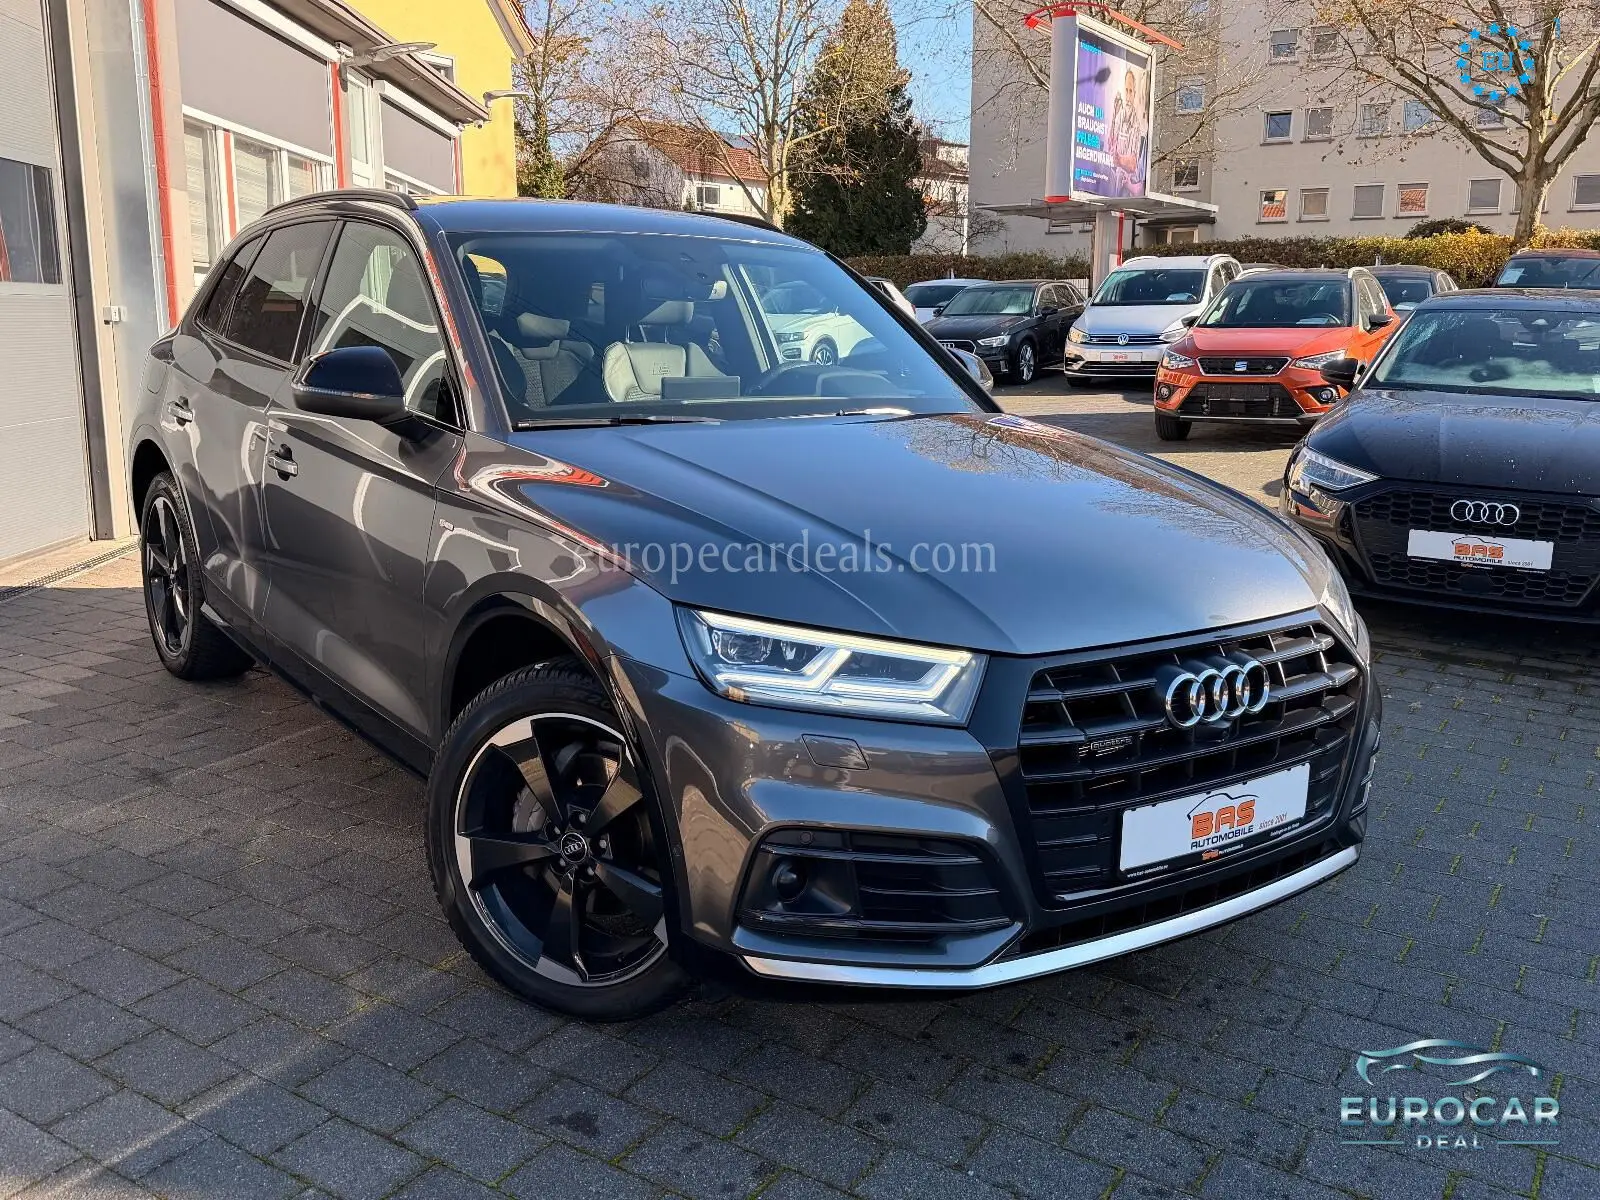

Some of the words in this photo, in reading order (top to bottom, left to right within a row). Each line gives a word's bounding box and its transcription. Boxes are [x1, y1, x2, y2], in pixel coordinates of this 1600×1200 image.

[1453, 555, 1503, 564] AUTOMOBILE
[1454, 543, 1504, 558] BAS
[1192, 799, 1256, 840] BAS
[1190, 825, 1254, 850] AUTOMOBILE
